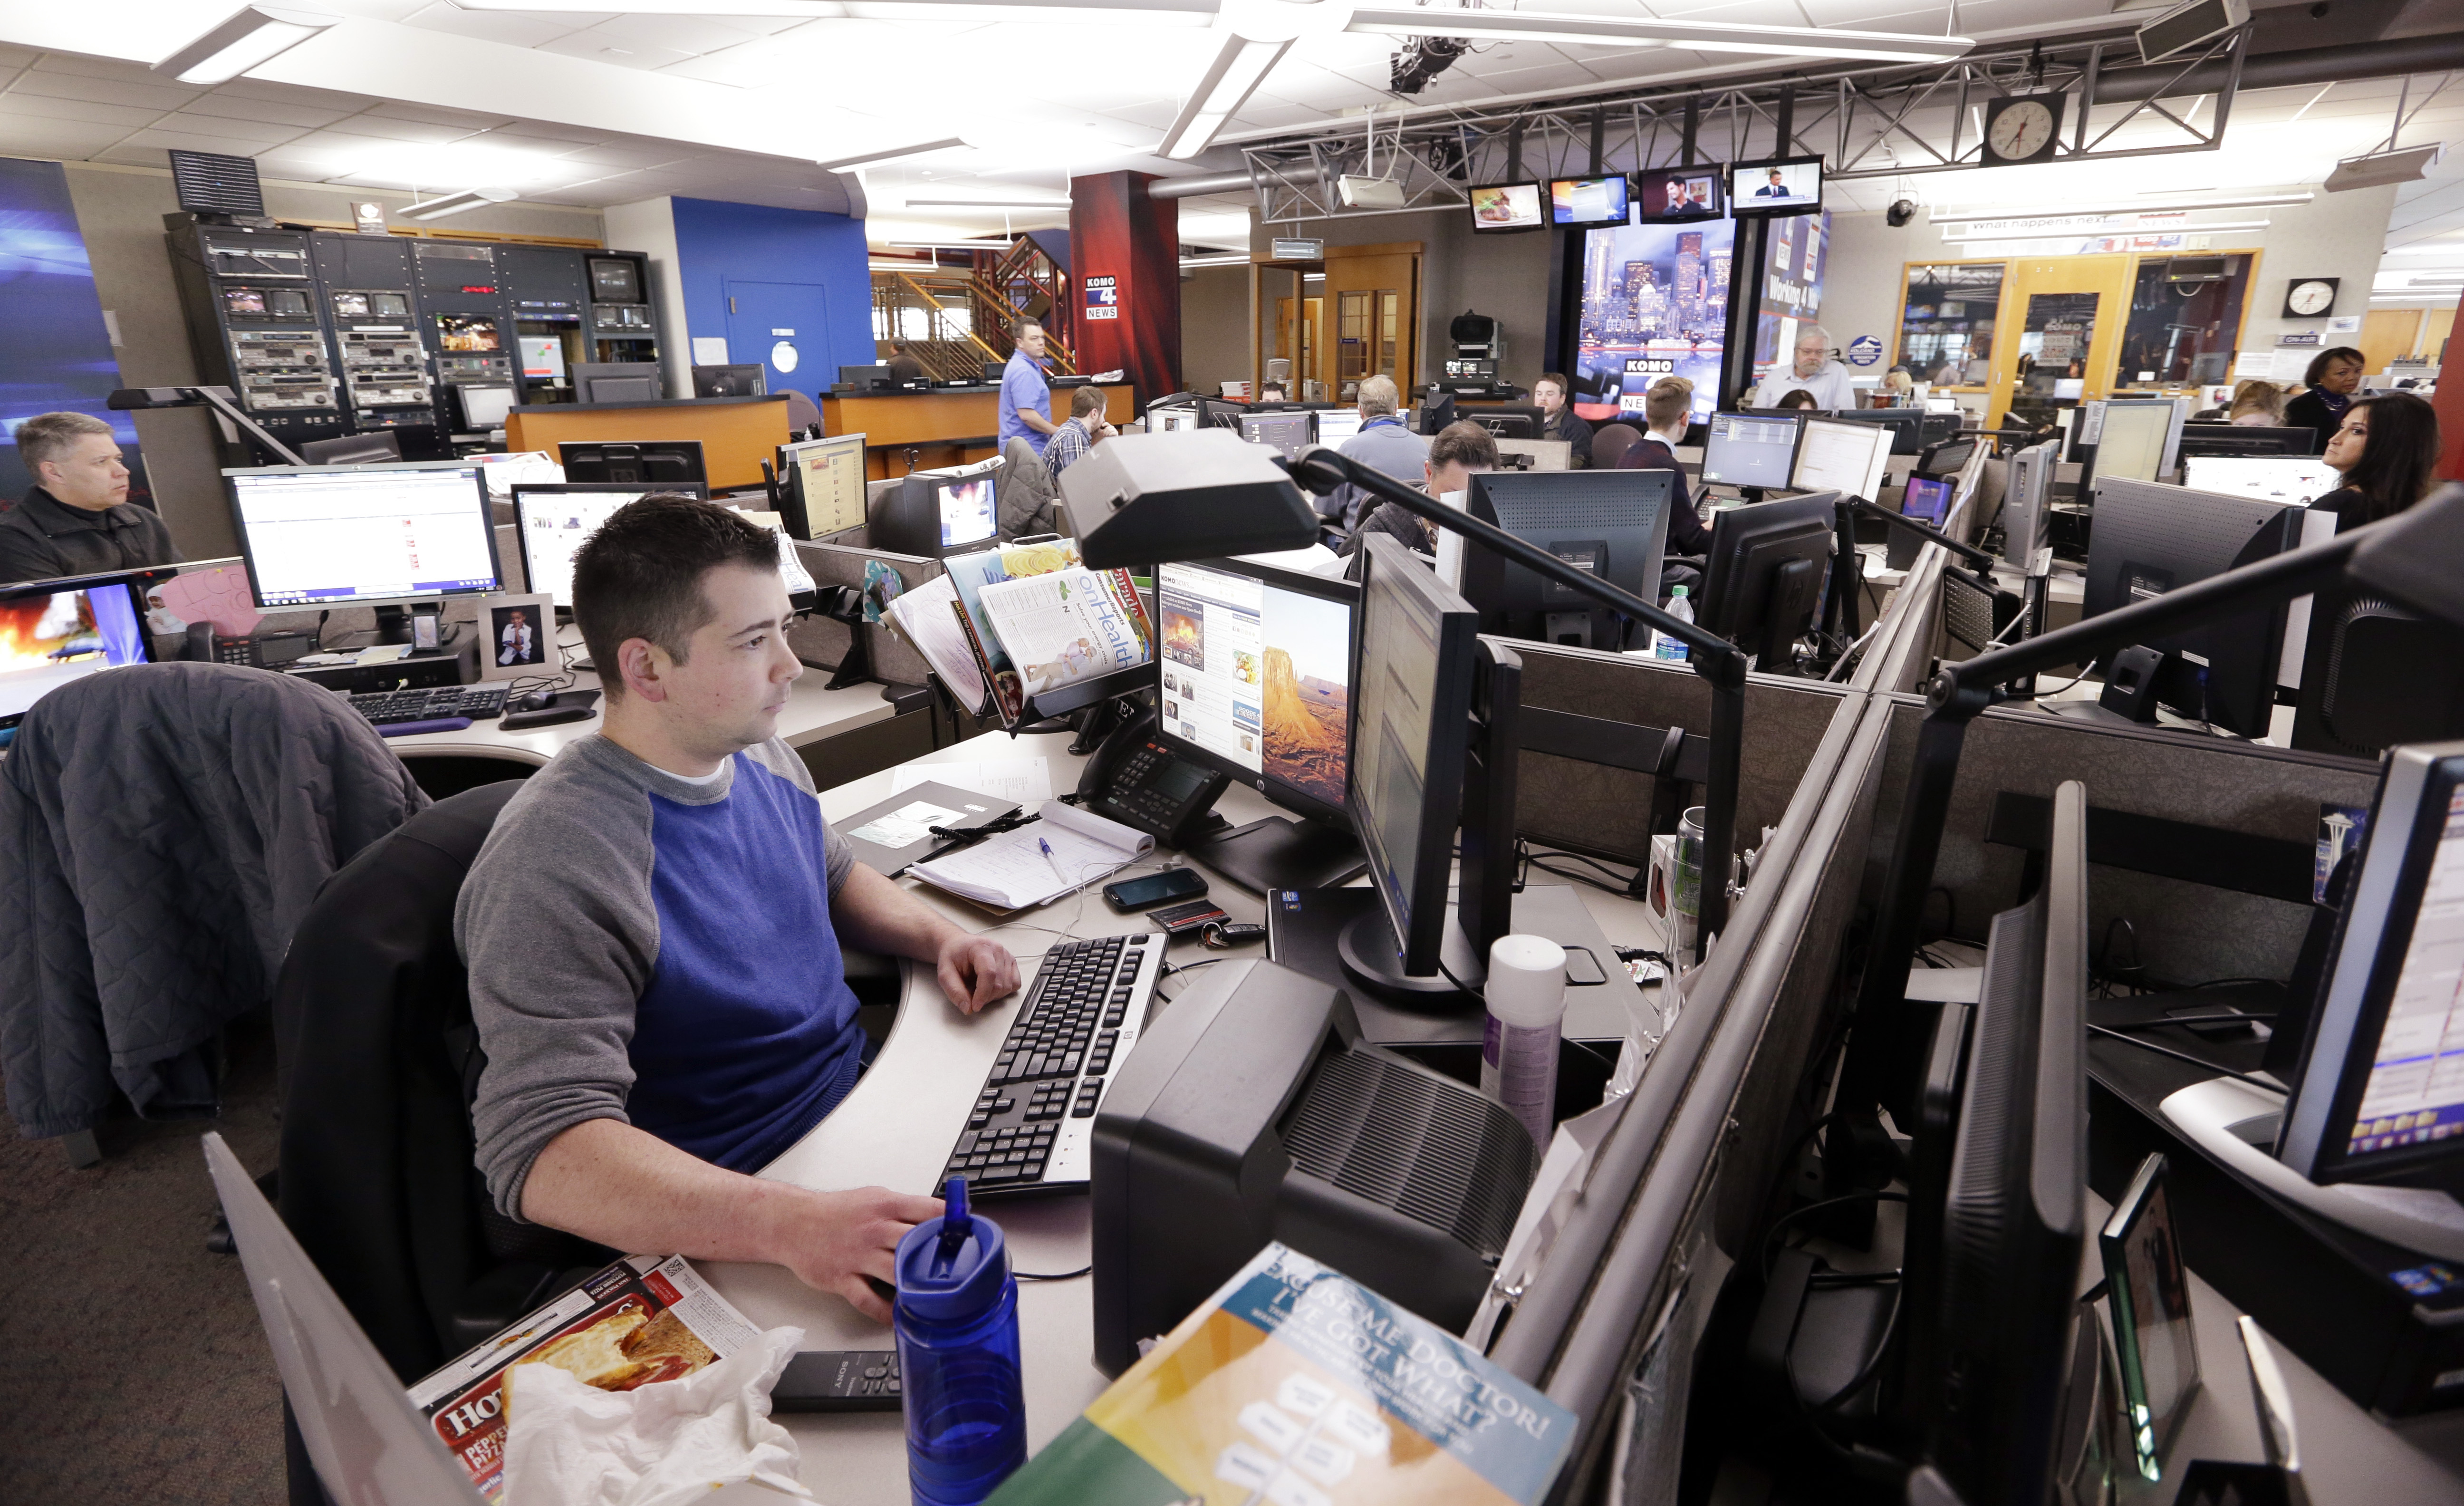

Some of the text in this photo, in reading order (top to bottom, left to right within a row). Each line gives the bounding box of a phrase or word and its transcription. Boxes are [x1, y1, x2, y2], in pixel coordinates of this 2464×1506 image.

[1087, 277, 1115, 287] KOMO
[1100, 289, 1117, 305] 4
[1769, 274, 1801, 310] Working
[1801, 286, 1807, 307] 4
[1089, 308, 1115, 318] NEWS
[1627, 360, 1672, 372] KOMO
[1625, 399, 1643, 408] NE
[787, 542, 808, 578] ConsumerReports
[1095, 573, 1126, 626] ConsumerReports
[1107, 570, 1128, 608] nsumerReports
[1076, 603, 1086, 617] Solve
[1083, 618, 1093, 630] your
[1092, 630, 1103, 649] energy
[1079, 575, 1135, 669] onHealth
[967, 628, 978, 652] cameras,
[975, 652, 986, 671] phones
[590, 1272, 626, 1295] PEPPERONI PIZZA
[1264, 1257, 1356, 1320] EXCUSE
[1357, 1310, 1405, 1348] ME
[1403, 1337, 1554, 1440] DOCTOR!
[1271, 1284, 1324, 1326] I'VE
[1323, 1318, 1389, 1367] GOT
[1387, 1357, 1499, 1435] WHAT?
[835, 1361, 849, 1389] SONY
[465, 1426, 509, 1459] PEPPE
